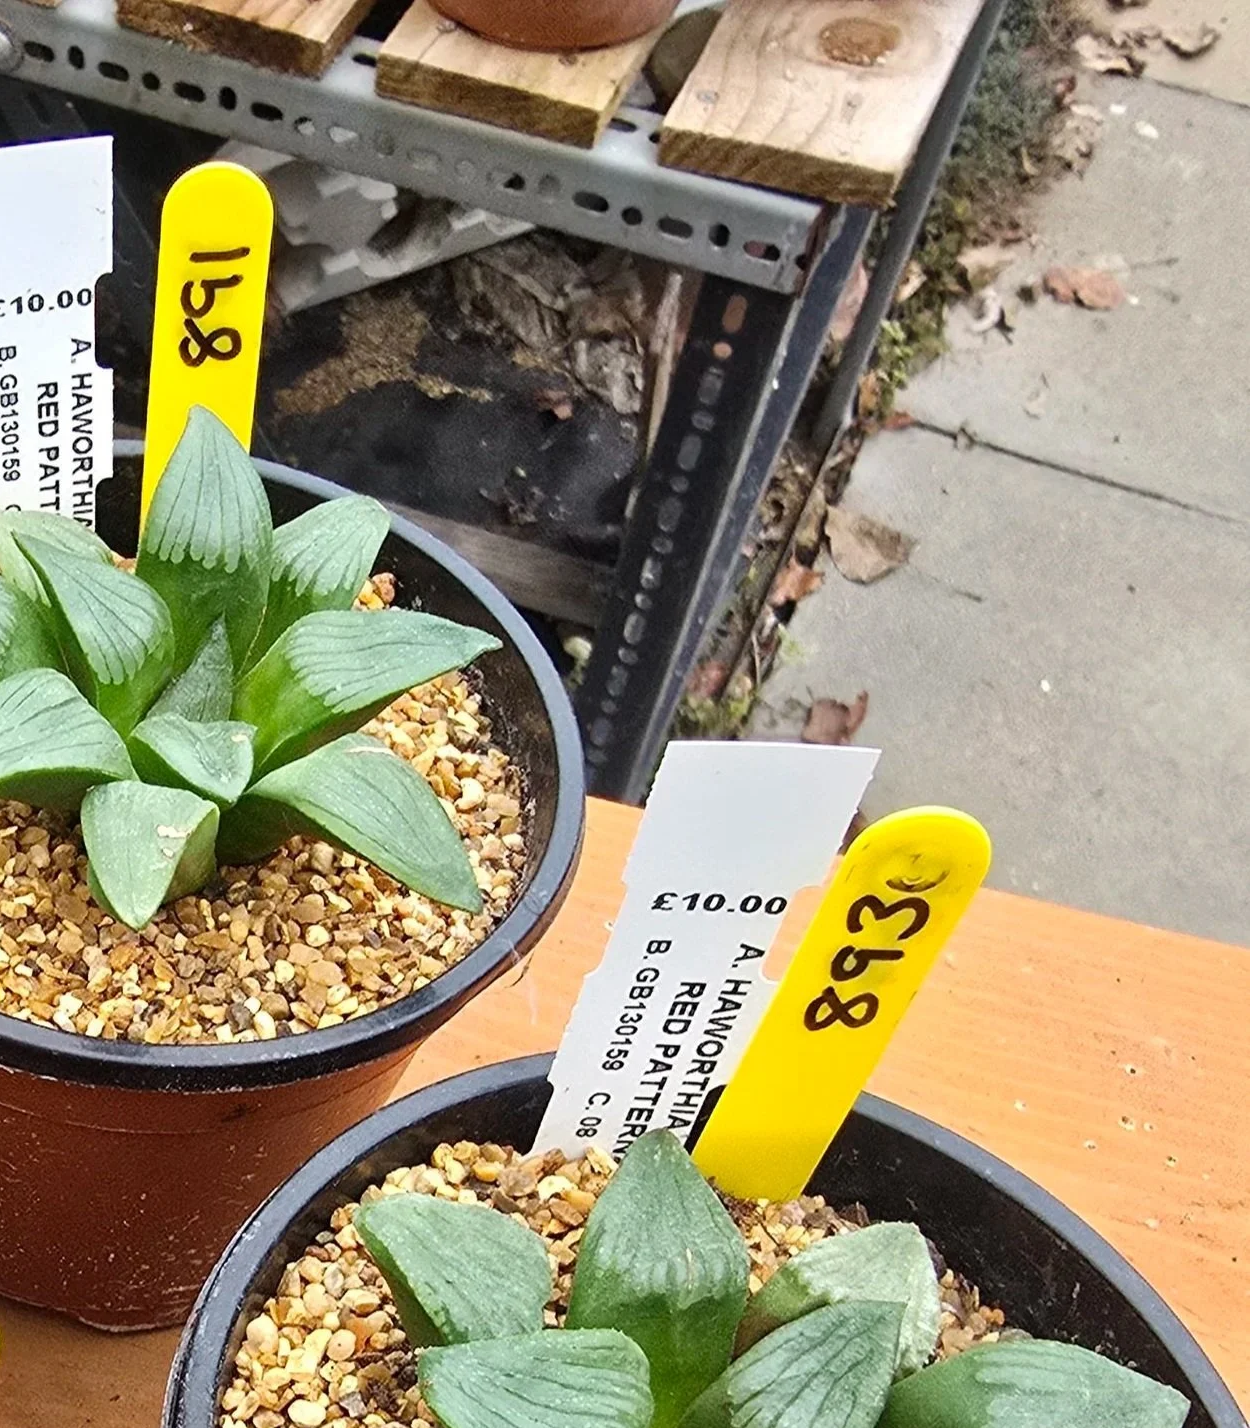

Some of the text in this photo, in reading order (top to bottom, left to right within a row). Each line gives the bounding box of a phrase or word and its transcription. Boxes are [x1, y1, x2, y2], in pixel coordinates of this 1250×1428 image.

[178, 247, 251, 367] 891
[70, 338, 92, 363] A.
[0, 374, 21, 482] GB130159
[37, 381, 60, 438] RED
[651, 892, 788, 915] £10.00
[804, 894, 930, 1031] 893
[601, 967, 660, 1071] GB130159
[662, 982, 707, 1035] RED
[666, 943, 766, 1130] A. HAWORTHIA
[575, 1116, 602, 1138] 08
